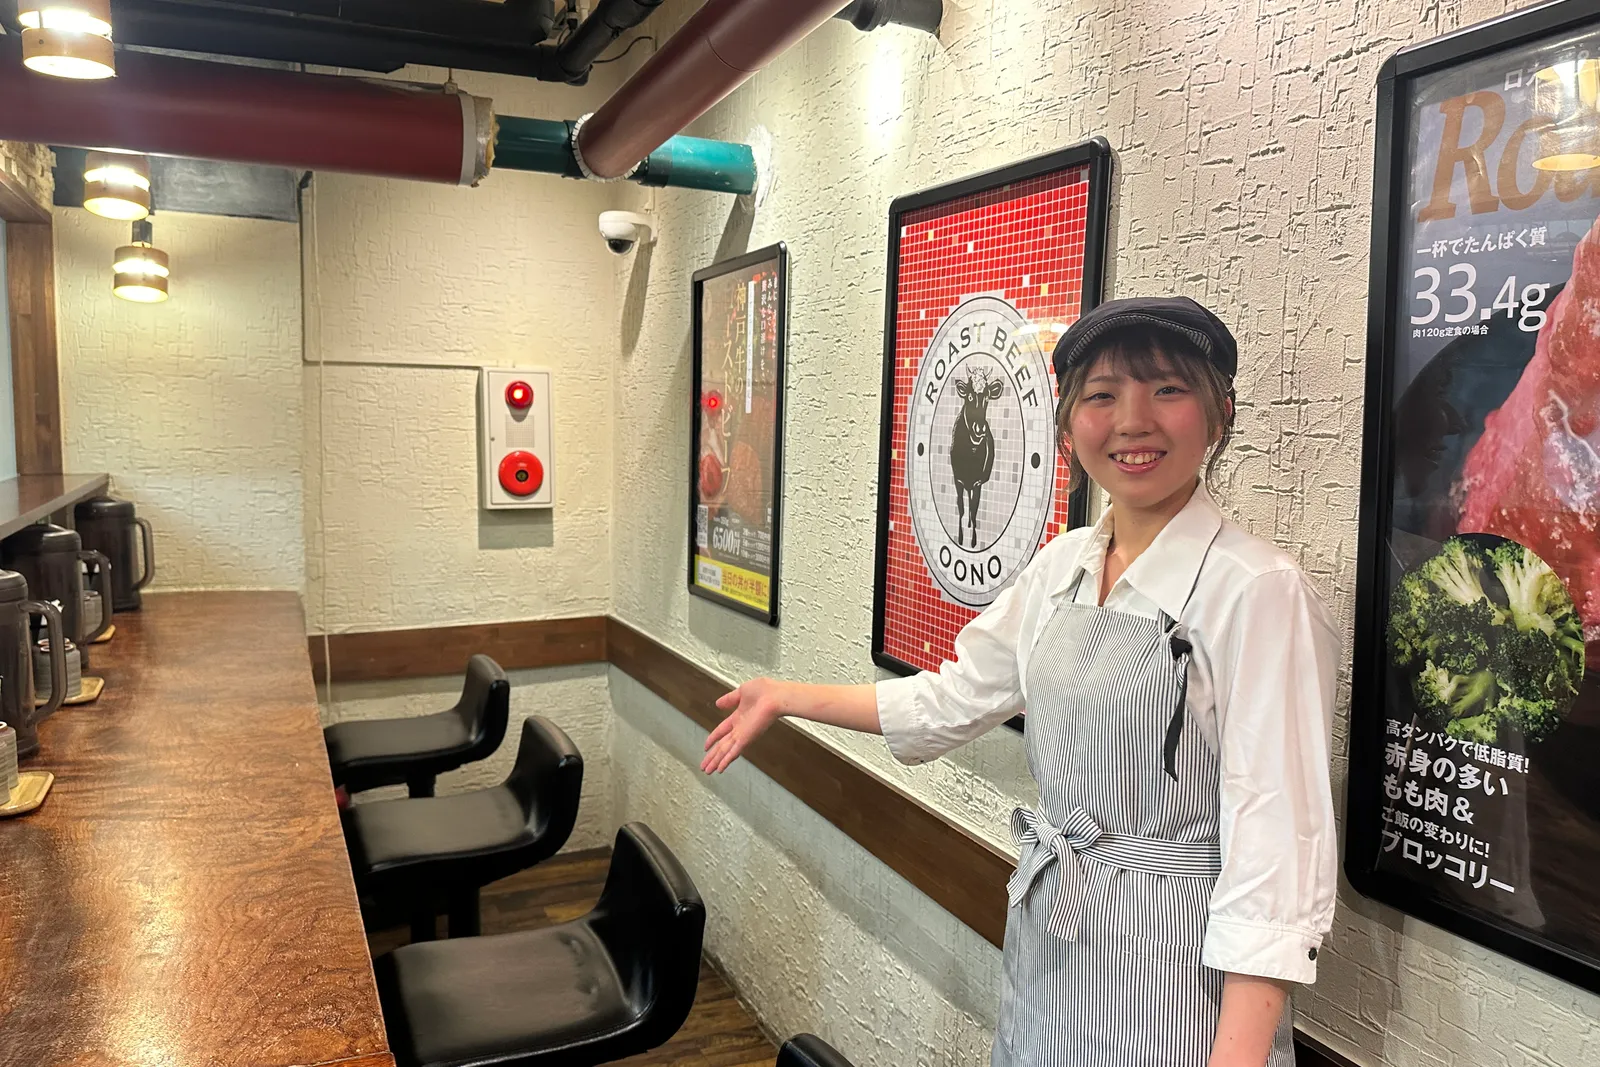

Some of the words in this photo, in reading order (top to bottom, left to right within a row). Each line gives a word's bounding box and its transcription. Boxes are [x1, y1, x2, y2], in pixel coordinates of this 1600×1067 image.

[1416, 226, 1547, 259] 一杯でたんぱく質
[1410, 262, 1550, 332] 33.4g
[735, 282, 746, 394] 神戸牛の
[1412, 324, 1489, 338] 肉120g定食の場合
[924, 321, 986, 405] ROAST
[991, 325, 1039, 408] BEEF
[939, 545, 1002, 586] OONO
[1384, 742, 1509, 796] 赤身の多い
[1381, 829, 1515, 893] ブロッコリー
